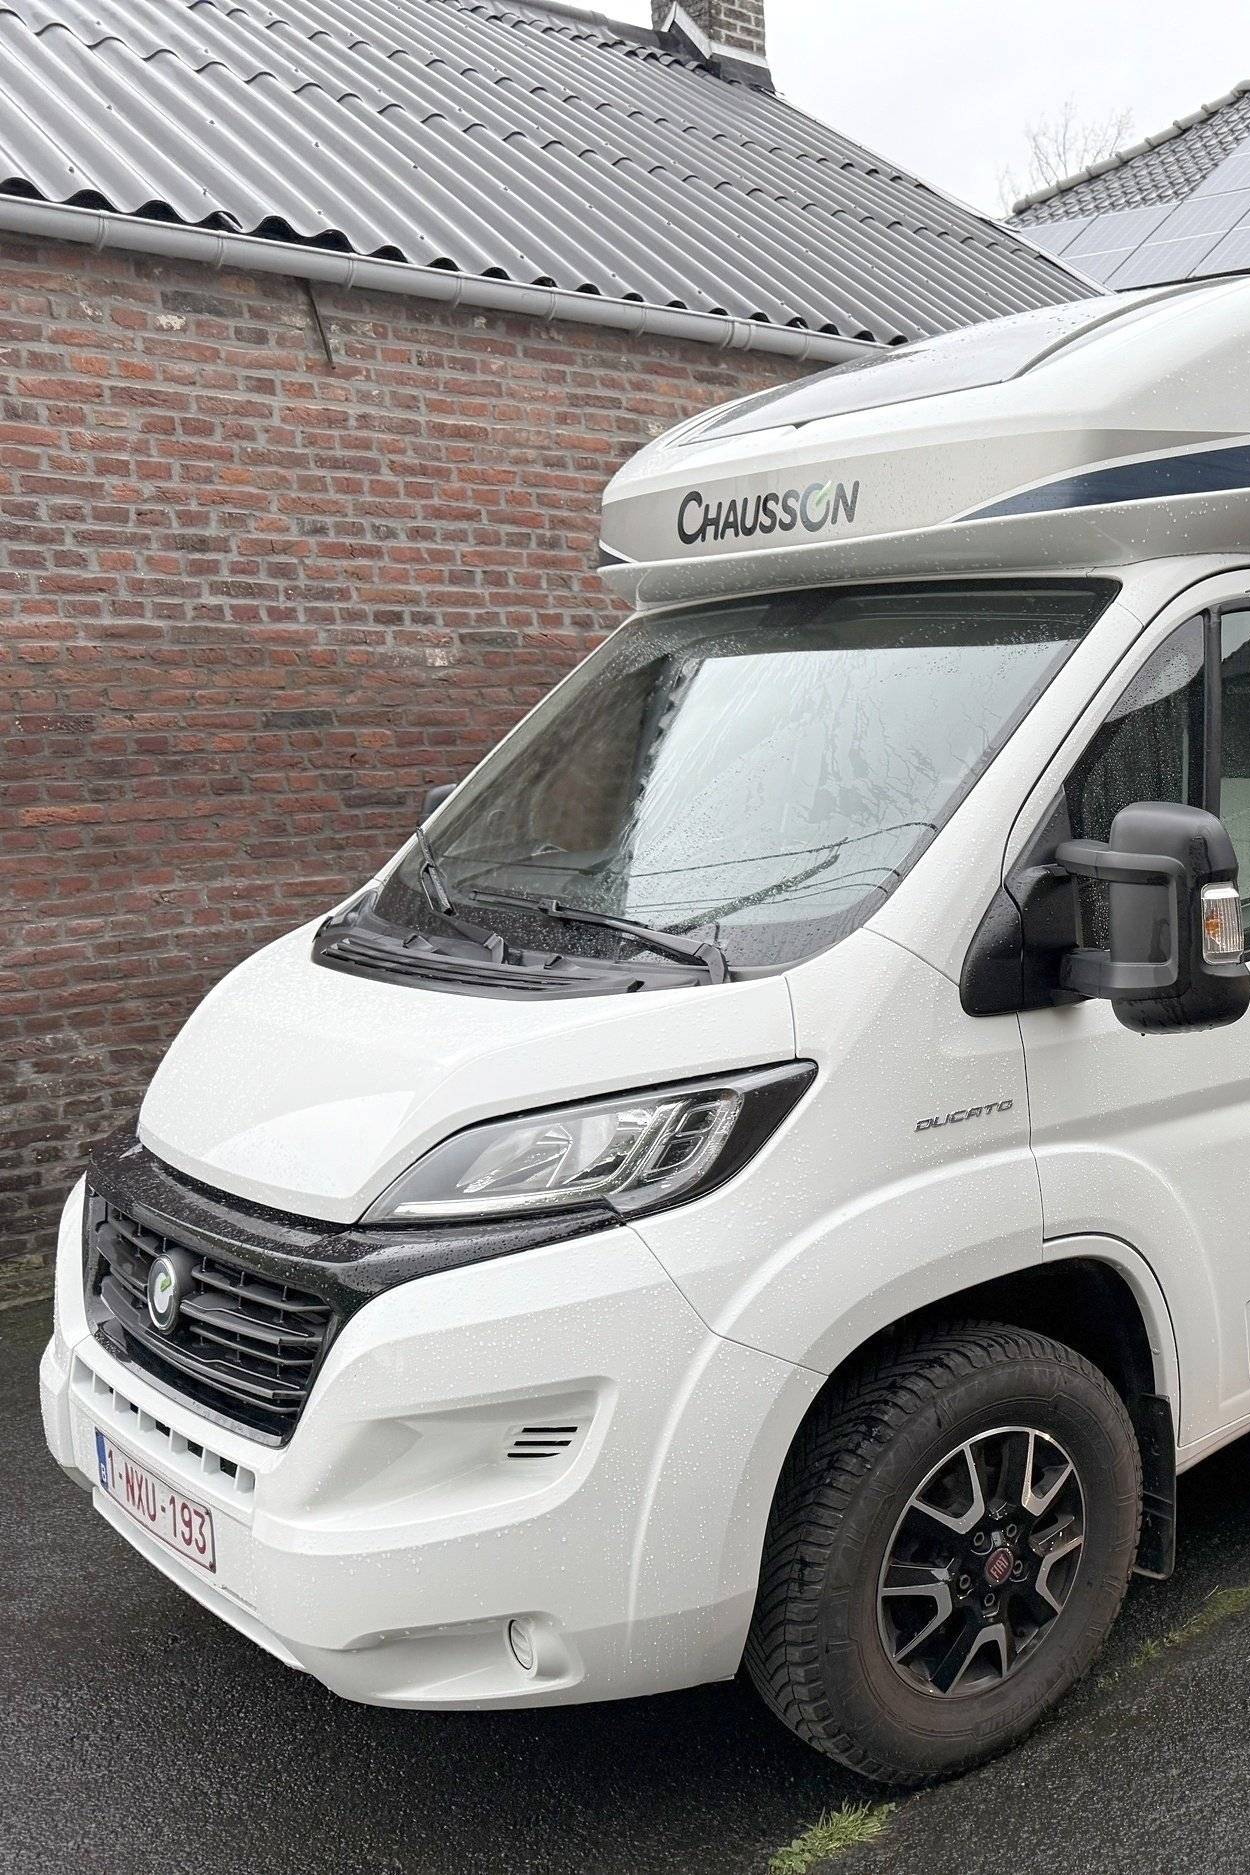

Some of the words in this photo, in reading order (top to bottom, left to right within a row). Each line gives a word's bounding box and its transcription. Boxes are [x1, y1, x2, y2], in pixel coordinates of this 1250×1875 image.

[677, 480, 860, 545] CHAUSSON
[913, 1099, 1014, 1134] DUCATO
[108, 1449, 207, 1555] 1-NXU-193
[989, 1553, 1009, 1579] FIAT
